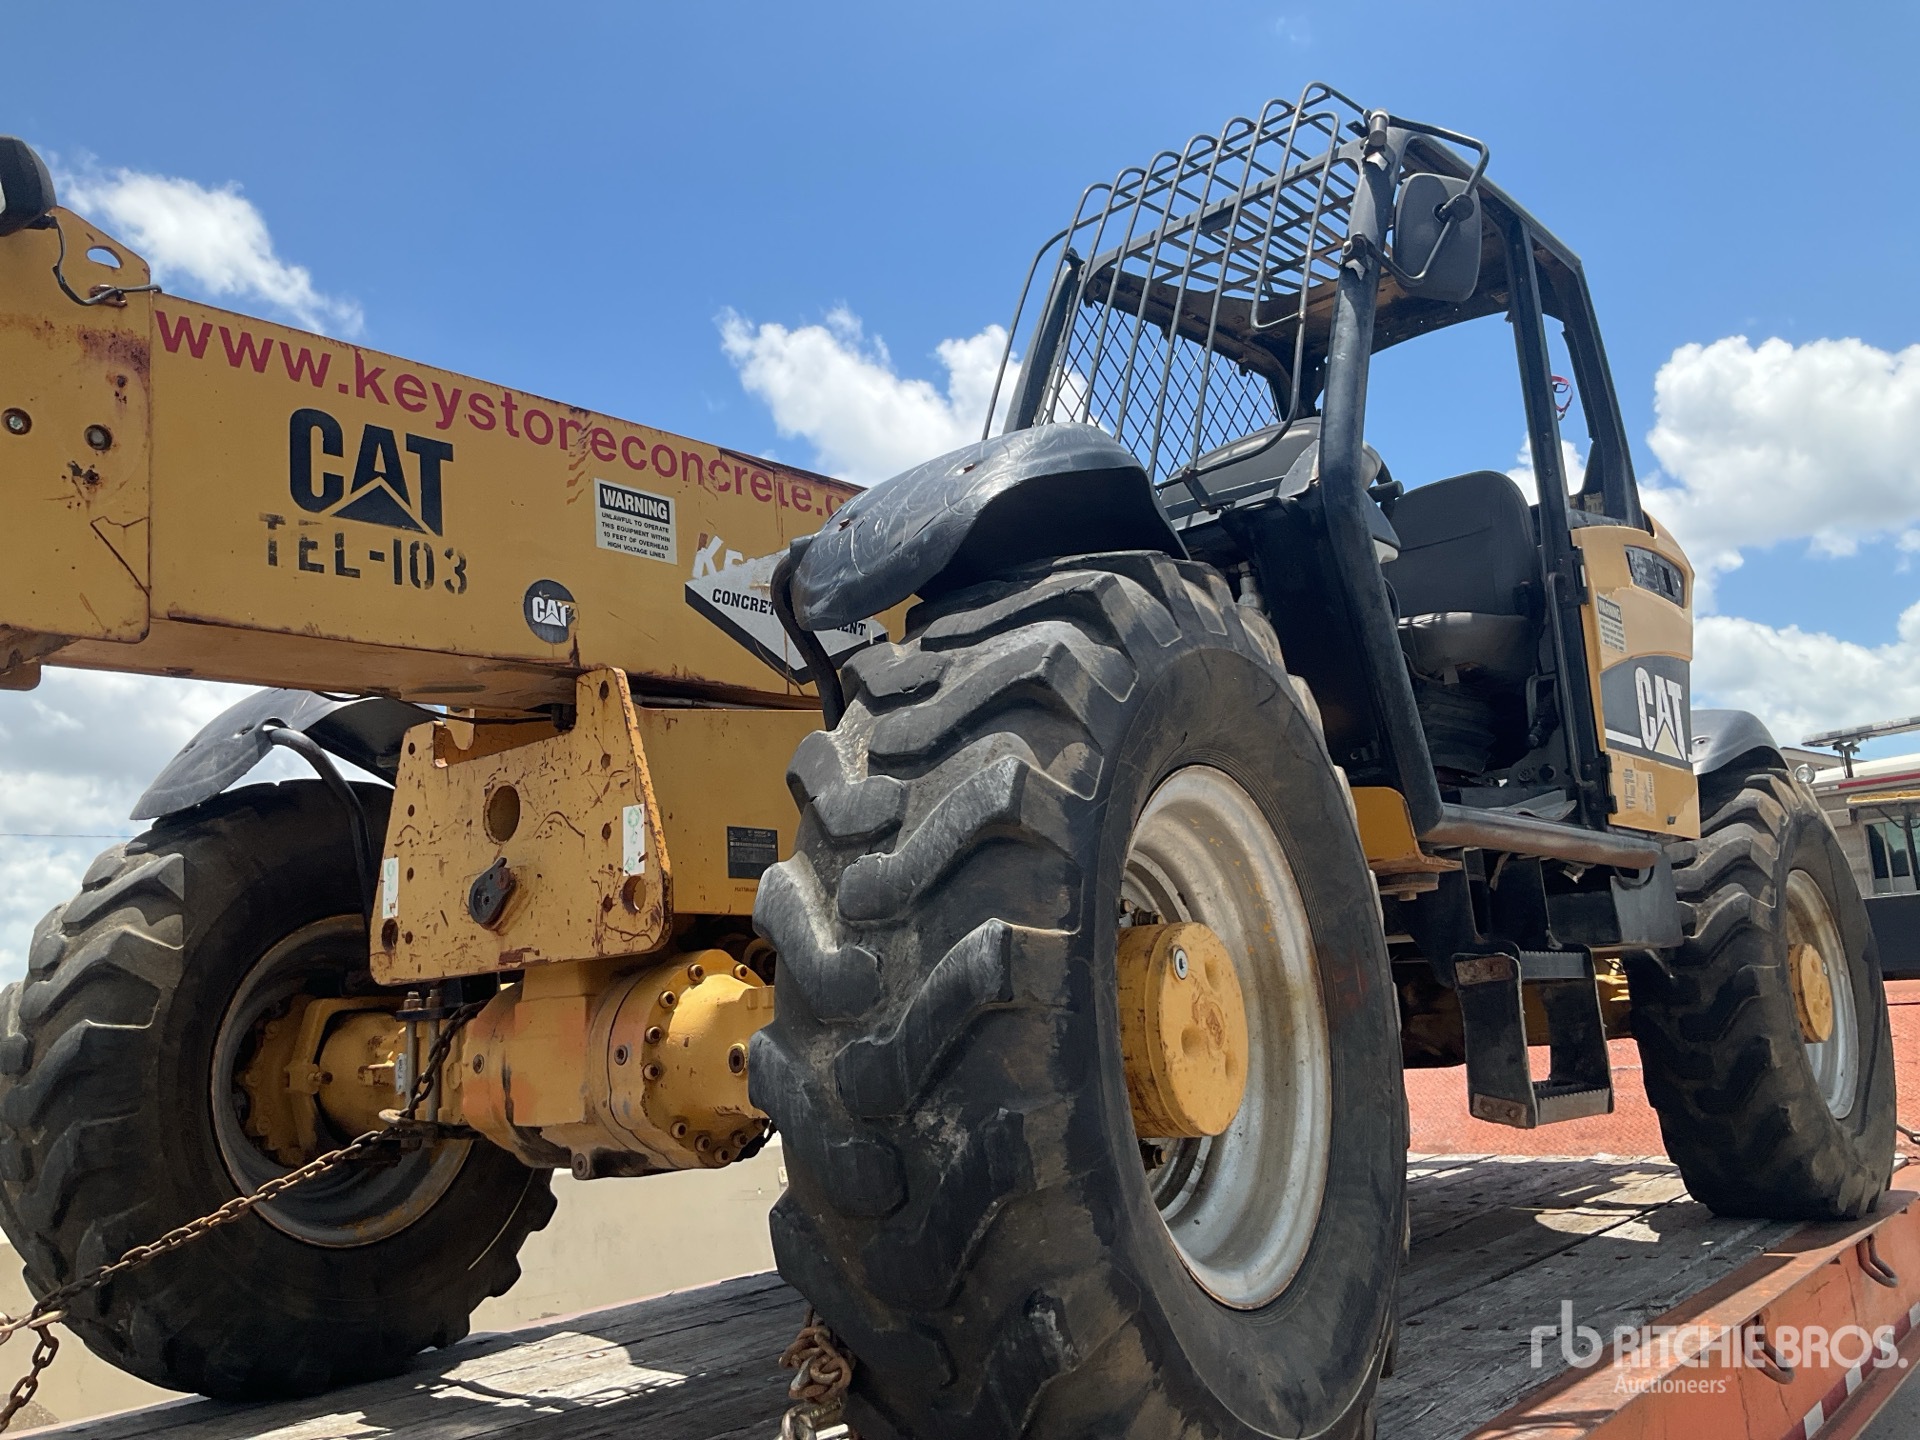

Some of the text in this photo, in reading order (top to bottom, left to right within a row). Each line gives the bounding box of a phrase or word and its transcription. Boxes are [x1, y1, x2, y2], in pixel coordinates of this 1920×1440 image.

[155, 309, 845, 517] www.keystoneconcrete.c
[289, 408, 454, 536] CAT
[602, 488, 668, 520] WARNING
[601, 511, 669, 533] UNLAWFUL TO OPERATE
[601, 521, 670, 543] THIS EQUIPMENT WITHIN
[259, 512, 468, 595] TEL-103
[607, 541, 666, 559] HIGH VOLTAGE LINES
[612, 533, 627, 542] FEET
[638, 539, 669, 551] OVERHEAD
[532, 597, 570, 627] CAT
[712, 588, 775, 616] CONCRET
[1635, 666, 1688, 761] CAT
